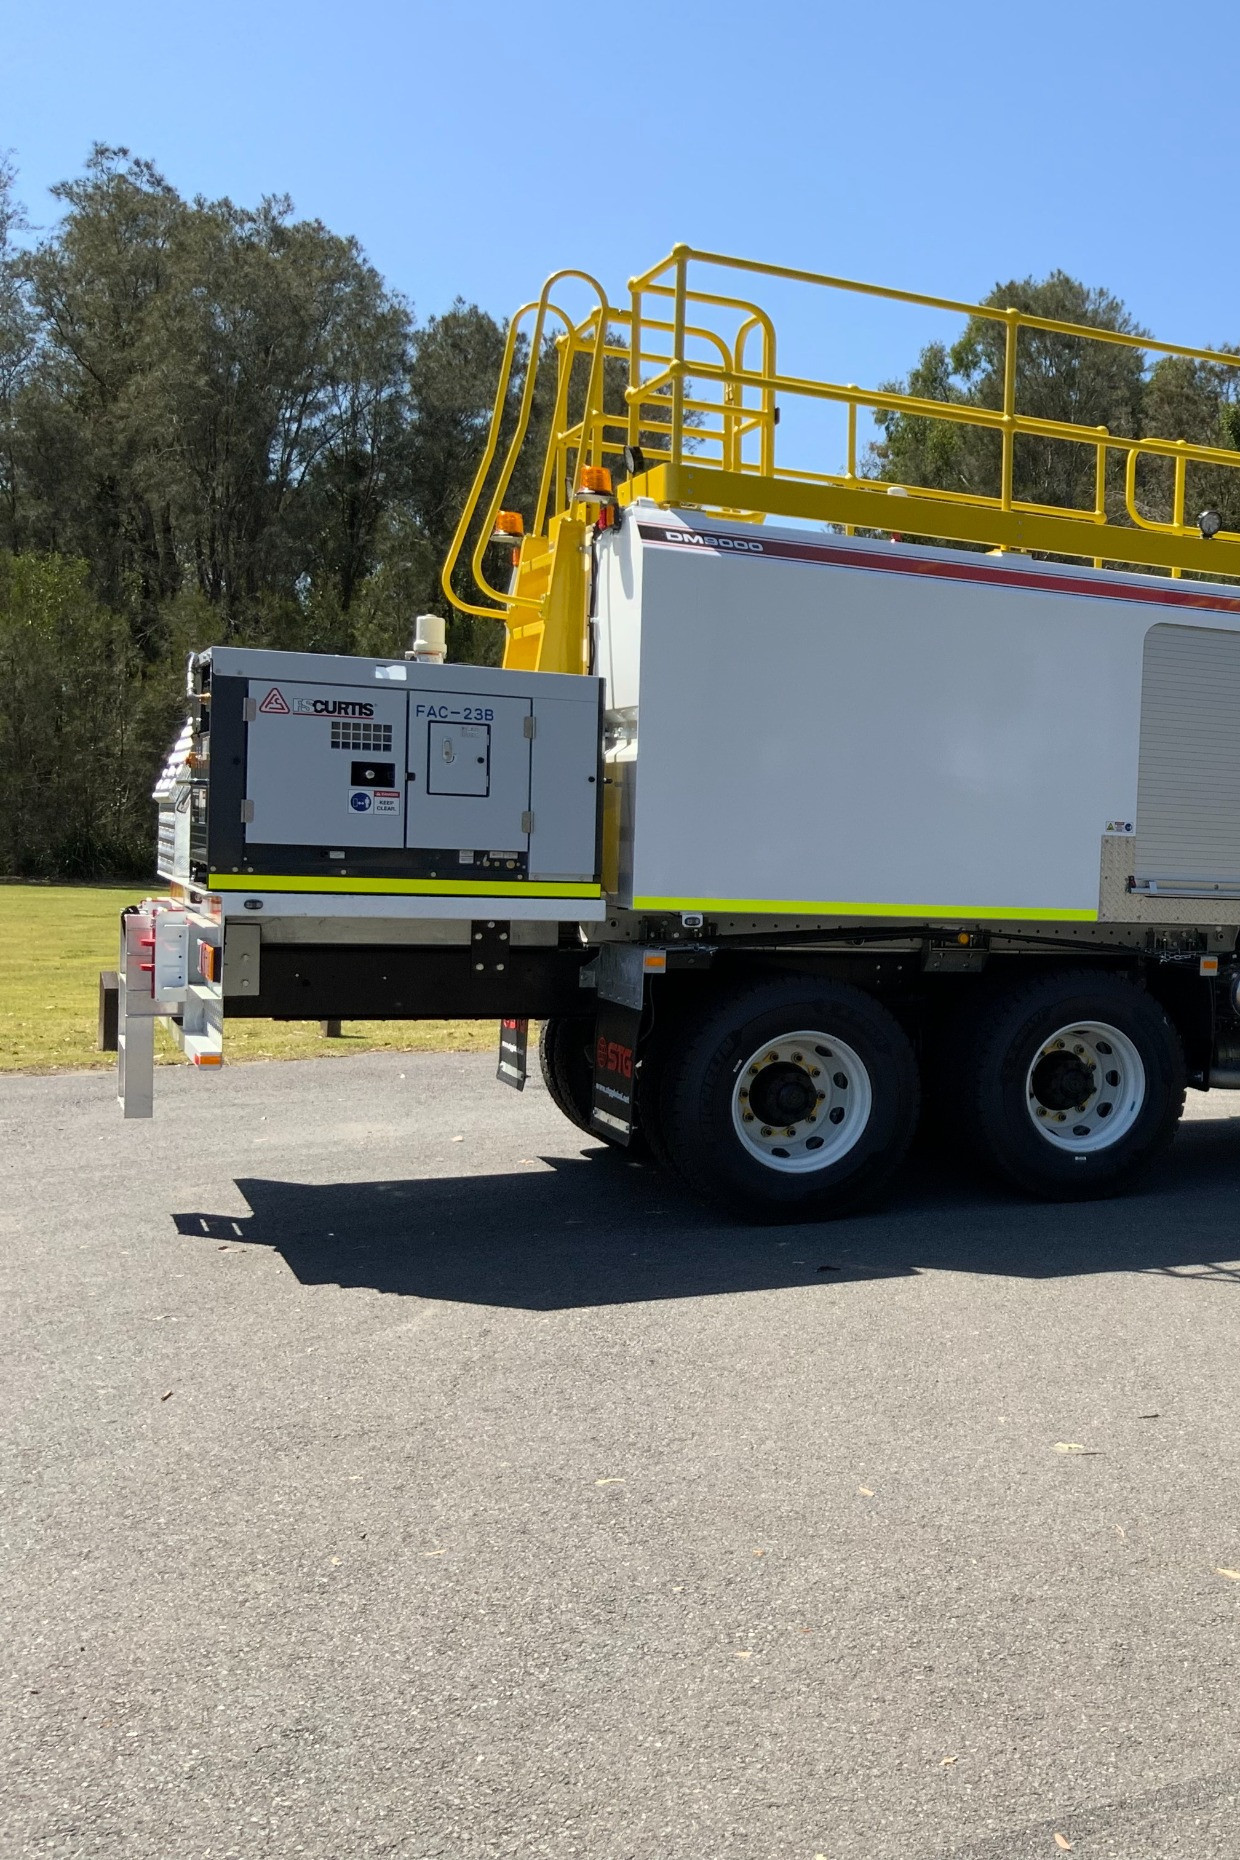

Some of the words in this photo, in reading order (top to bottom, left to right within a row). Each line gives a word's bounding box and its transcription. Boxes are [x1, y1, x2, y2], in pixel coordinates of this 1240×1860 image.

[665, 531, 764, 551] DM9000
[415, 704, 494, 721] FAC-23B
[607, 1042, 633, 1078] STG
